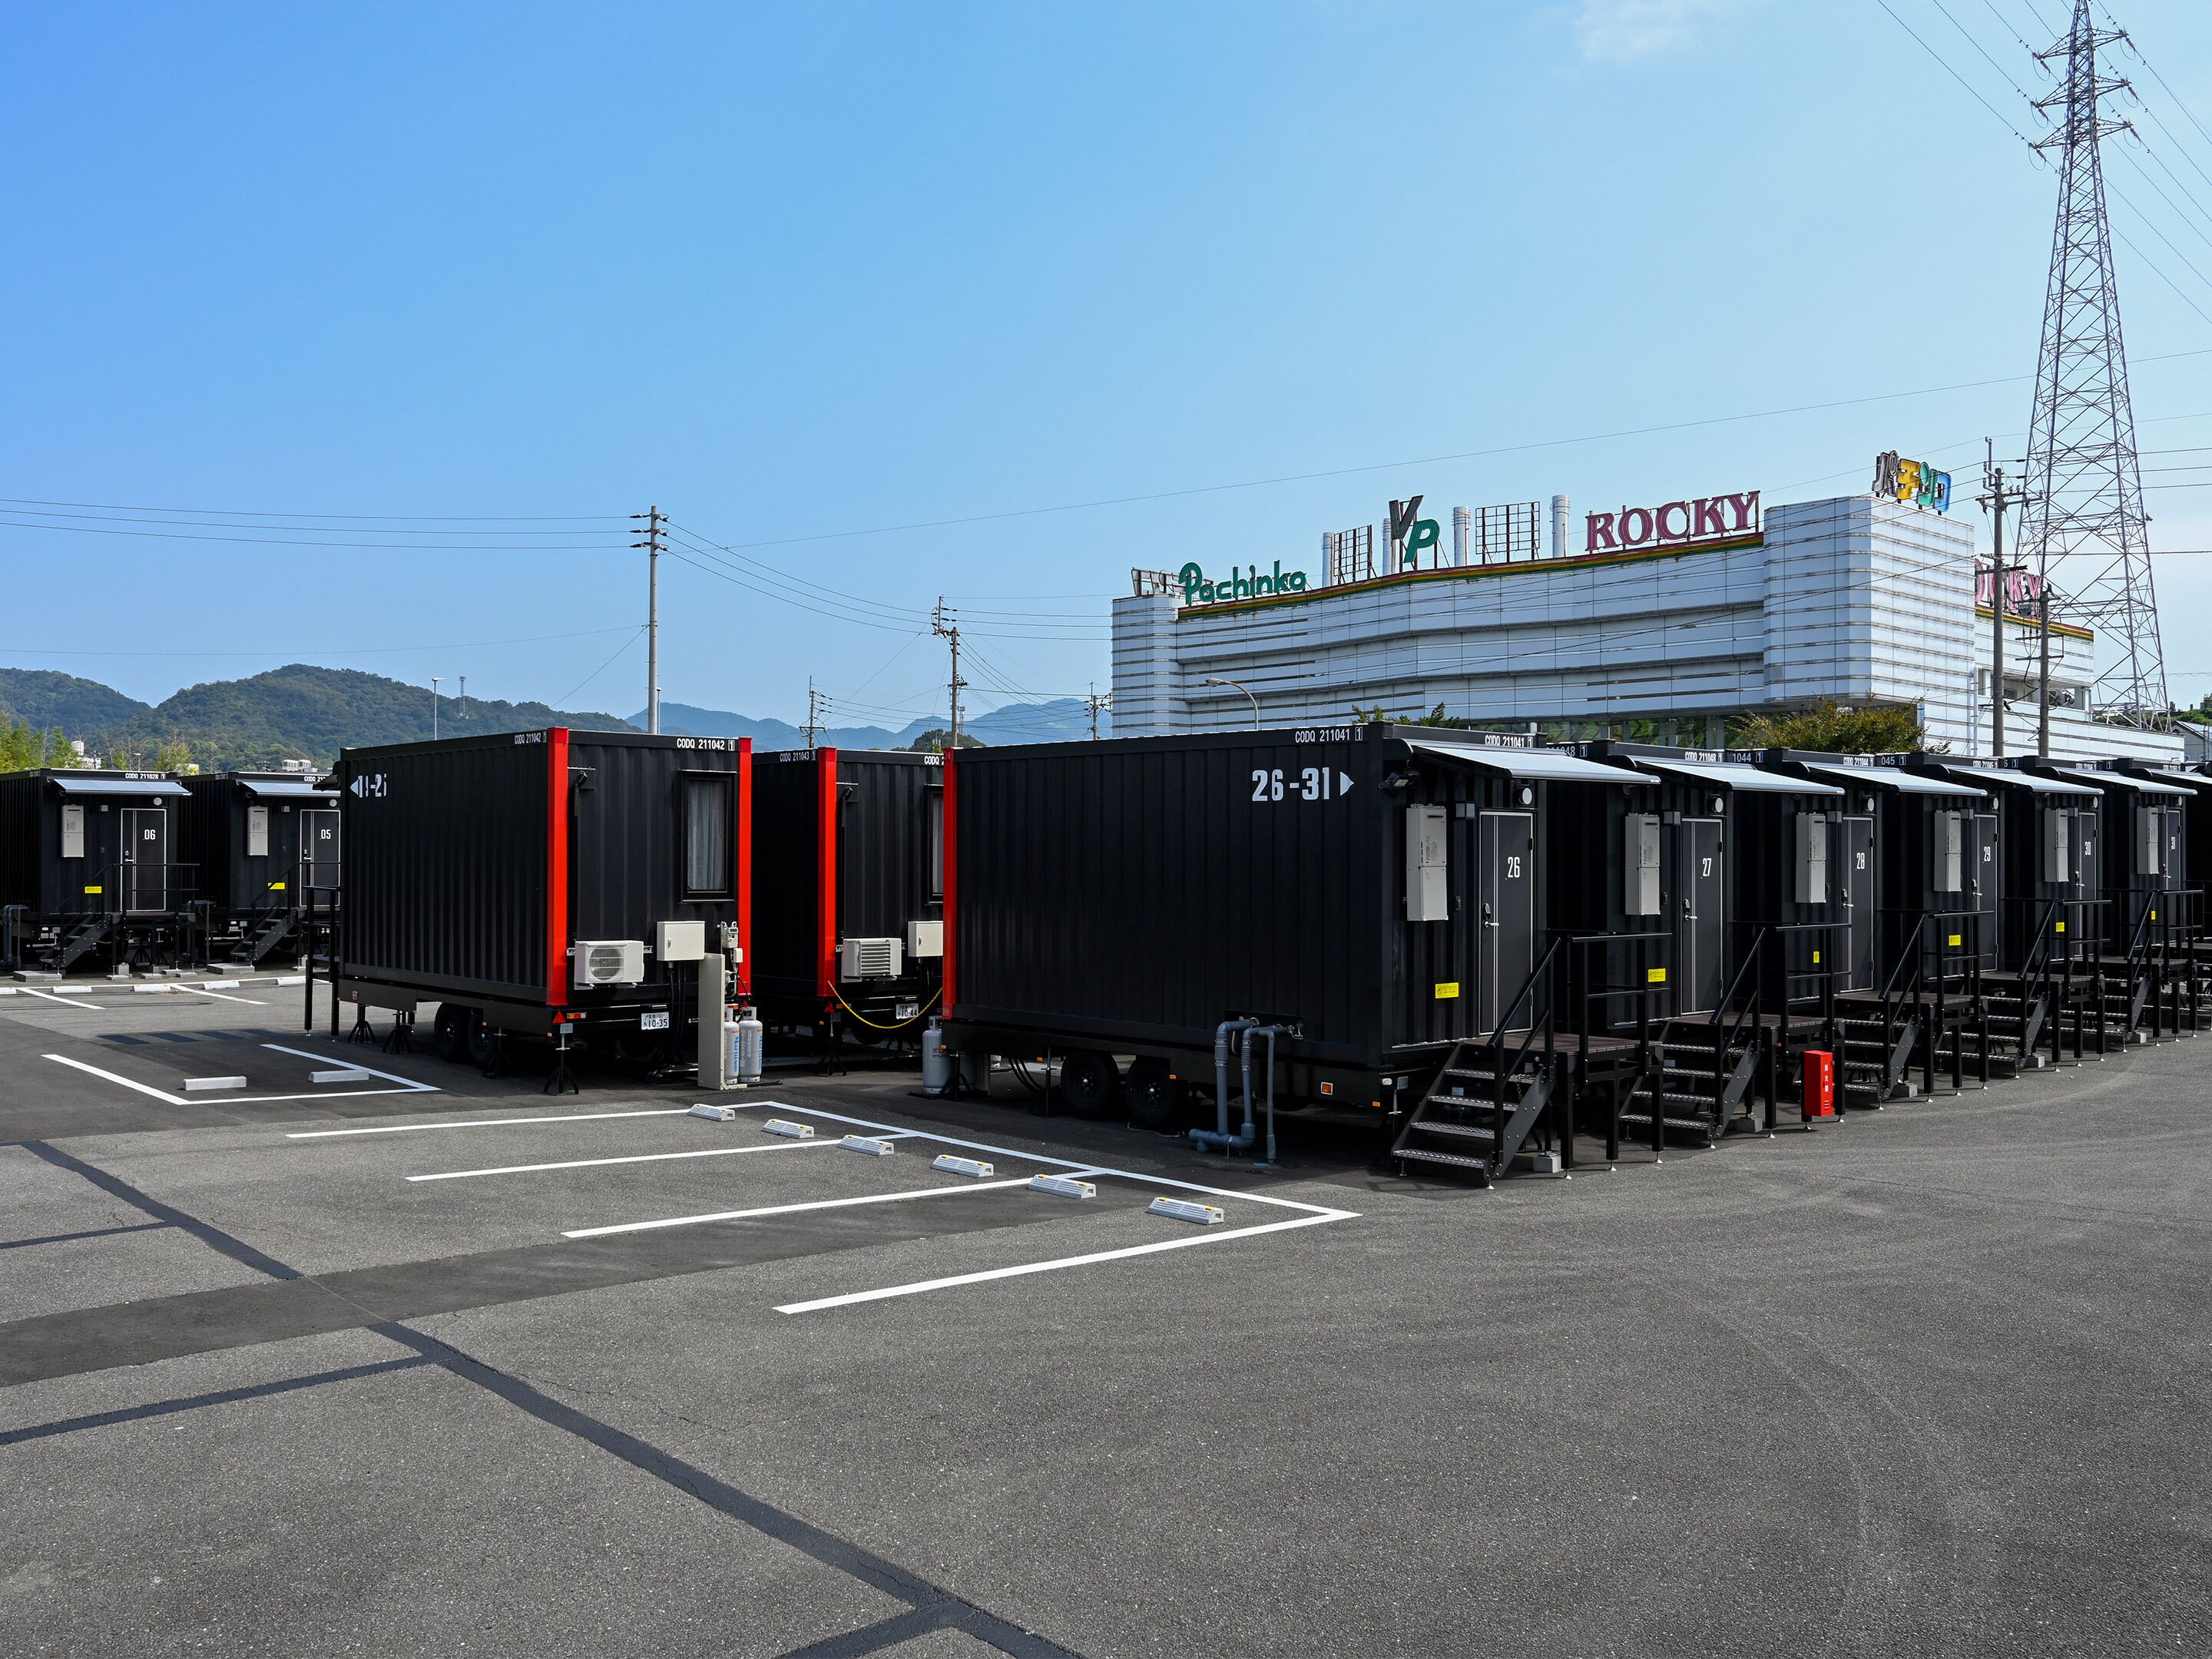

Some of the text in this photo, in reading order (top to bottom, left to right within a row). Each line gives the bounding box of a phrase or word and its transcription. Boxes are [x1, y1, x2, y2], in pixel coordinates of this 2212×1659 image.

[1584, 490, 1761, 551] ROCKY
[1178, 560, 1306, 605] Pachinko
[677, 738, 695, 748] CODQ
[698, 739, 725, 750] 211042
[1295, 730, 1315, 743] CODQ
[1320, 728, 1349, 741] 211041
[1252, 767, 1330, 801] 26-31
[144, 830, 156, 840] 06
[321, 830, 331, 839] 05
[1508, 856, 1520, 878] 26
[1702, 858, 1712, 877] 27
[1857, 852, 1865, 869] 28
